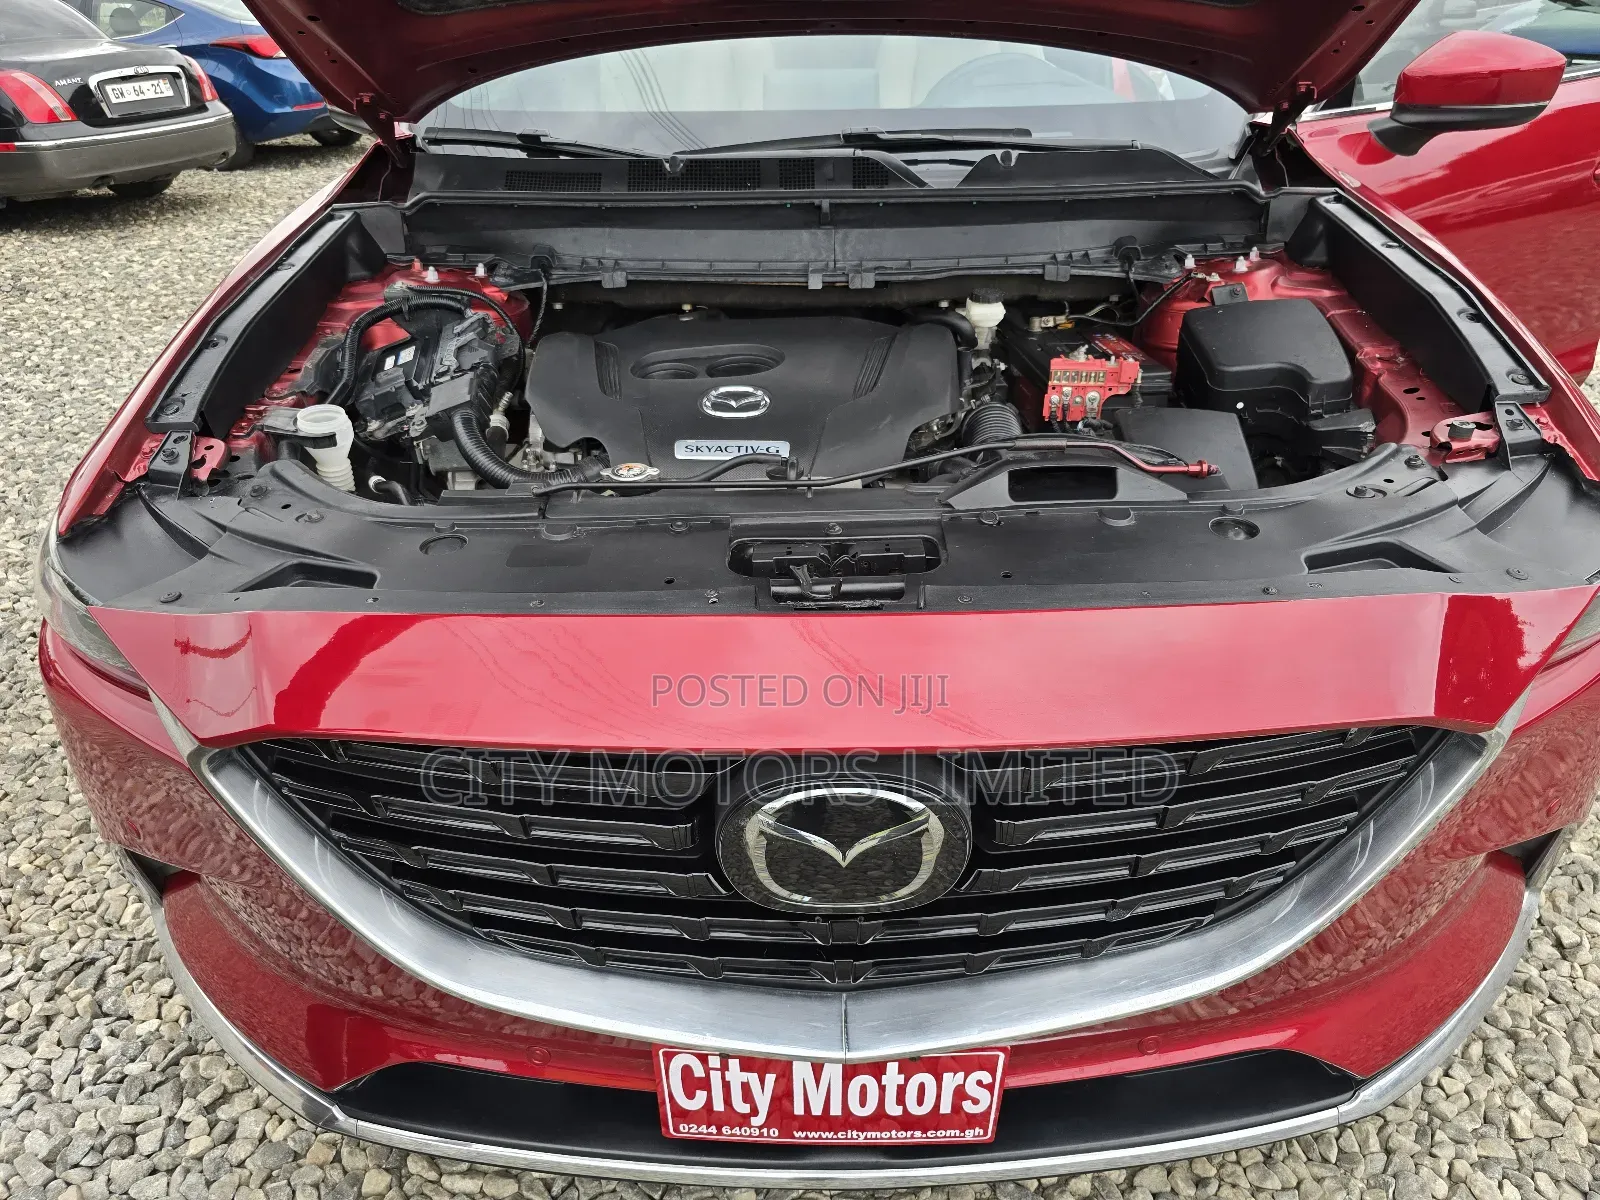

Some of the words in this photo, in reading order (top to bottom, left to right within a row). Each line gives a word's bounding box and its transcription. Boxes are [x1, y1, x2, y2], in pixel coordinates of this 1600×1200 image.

[684, 444, 780, 454] SKYACTIV-G
[668, 1054, 777, 1126] City
[792, 1061, 993, 1116] Motors
[679, 1123, 718, 1135] 0244
[722, 1125, 779, 1138] 640910
[793, 1127, 984, 1140] www.citymotors.com.gh
